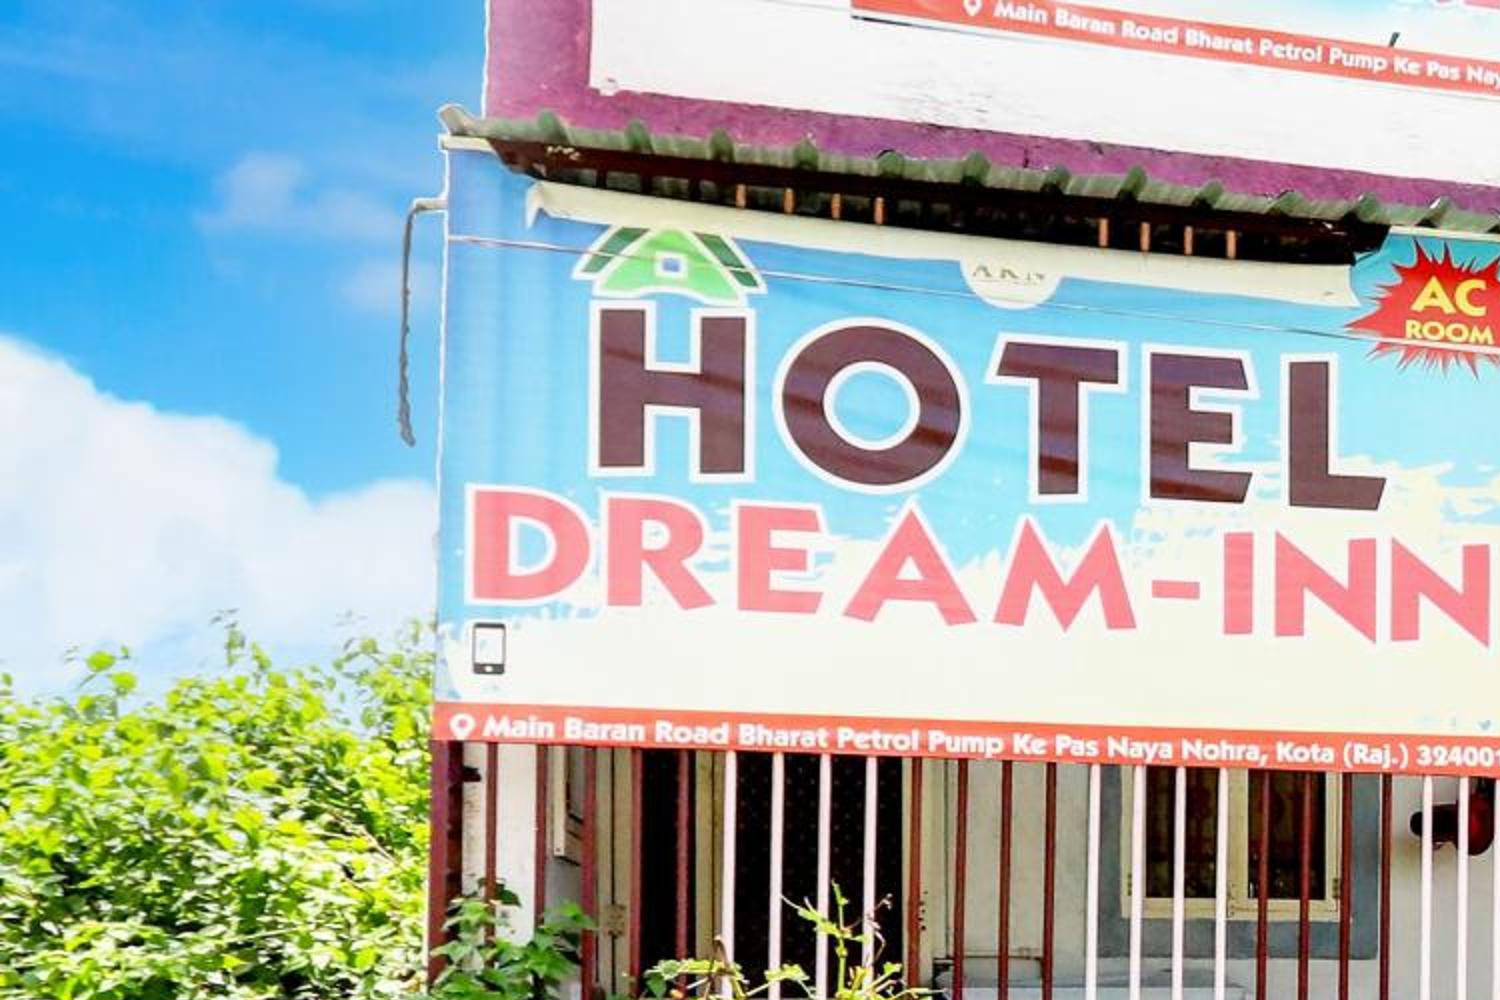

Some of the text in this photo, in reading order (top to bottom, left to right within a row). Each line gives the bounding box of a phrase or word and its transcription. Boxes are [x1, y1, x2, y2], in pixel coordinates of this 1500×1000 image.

[994, 1, 1048, 25] Main
[1055, 8, 1115, 34] Baran
[1121, 20, 1179, 44] Road
[1184, 28, 1253, 54] Bharat
[1259, 38, 1322, 63] Petrol
[1329, 47, 1388, 72] Pump
[1393, 56, 1421, 74] Ke
[1426, 60, 1460, 81] Pas
[1409, 274, 1488, 318] AC
[1404, 320, 1495, 346] ROOM
[597, 306, 1388, 512] HOTEL
[472, 488, 1491, 649] DREAM-INN
[482, 716, 555, 739] Main
[563, 717, 647, 742] Baran
[654, 719, 729, 745] Road
[738, 721, 829, 749] Bharat
[836, 725, 920, 752] Petrol
[926, 729, 1005, 759] Pump
[1012, 733, 1047, 755] Ke
[1054, 734, 1099, 757] Pas
[1107, 736, 1173, 765] Naya
[1180, 737, 1268, 765] Nohra,
[1276, 740, 1335, 763] Kota
[1343, 739, 1409, 768] (Raj.)
